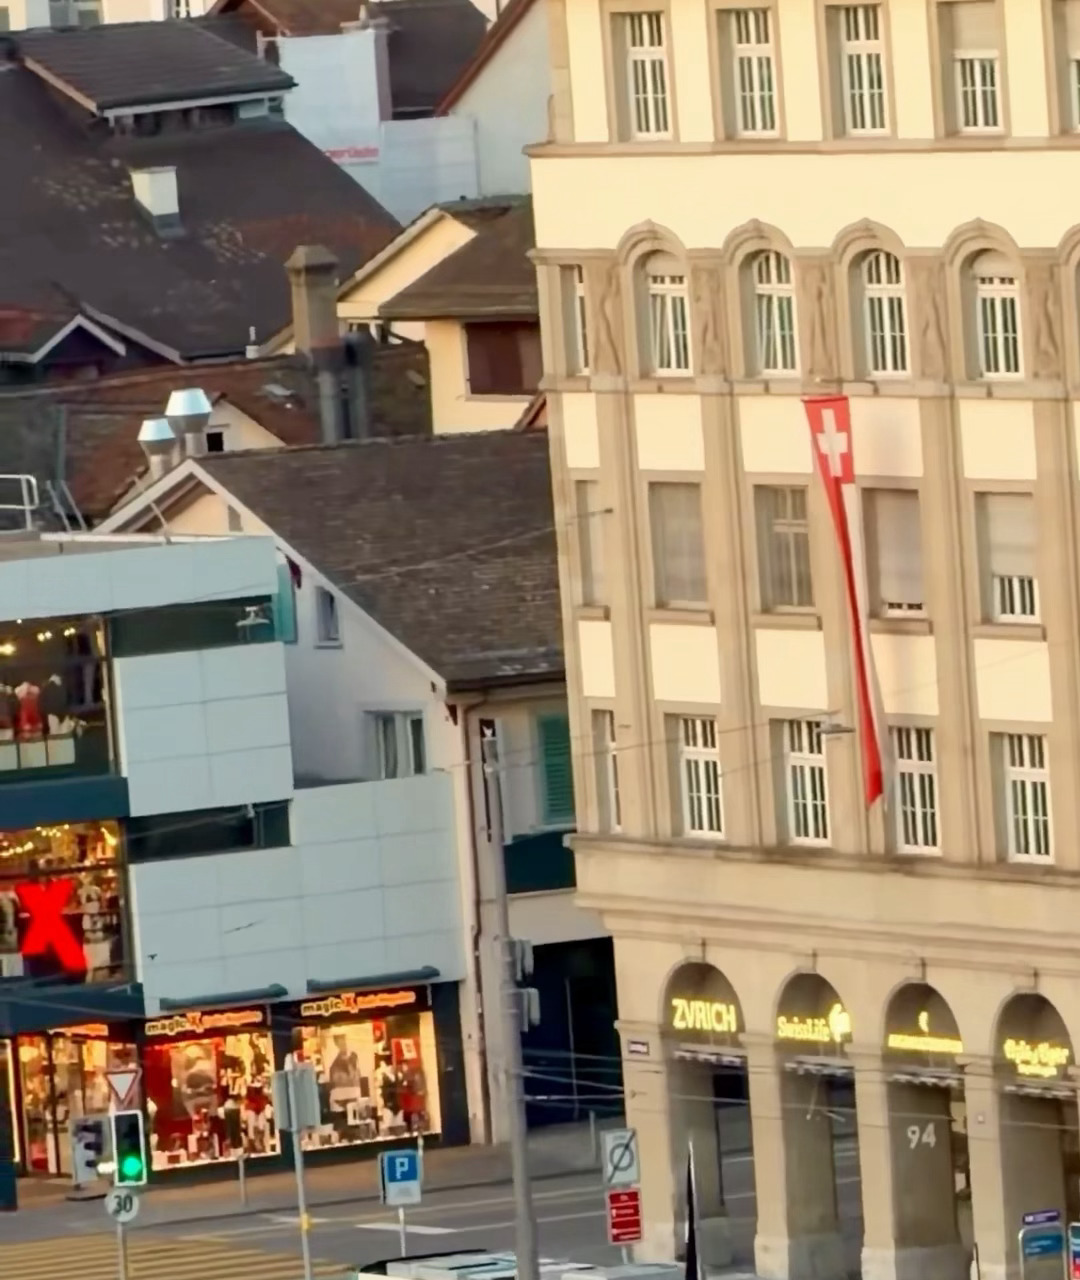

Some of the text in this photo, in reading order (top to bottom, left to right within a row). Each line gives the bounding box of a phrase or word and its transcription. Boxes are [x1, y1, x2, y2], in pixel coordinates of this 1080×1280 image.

[907, 1122, 937, 1149] 94
[395, 1157, 409, 1180] P
[112, 1194, 133, 1217] 30
